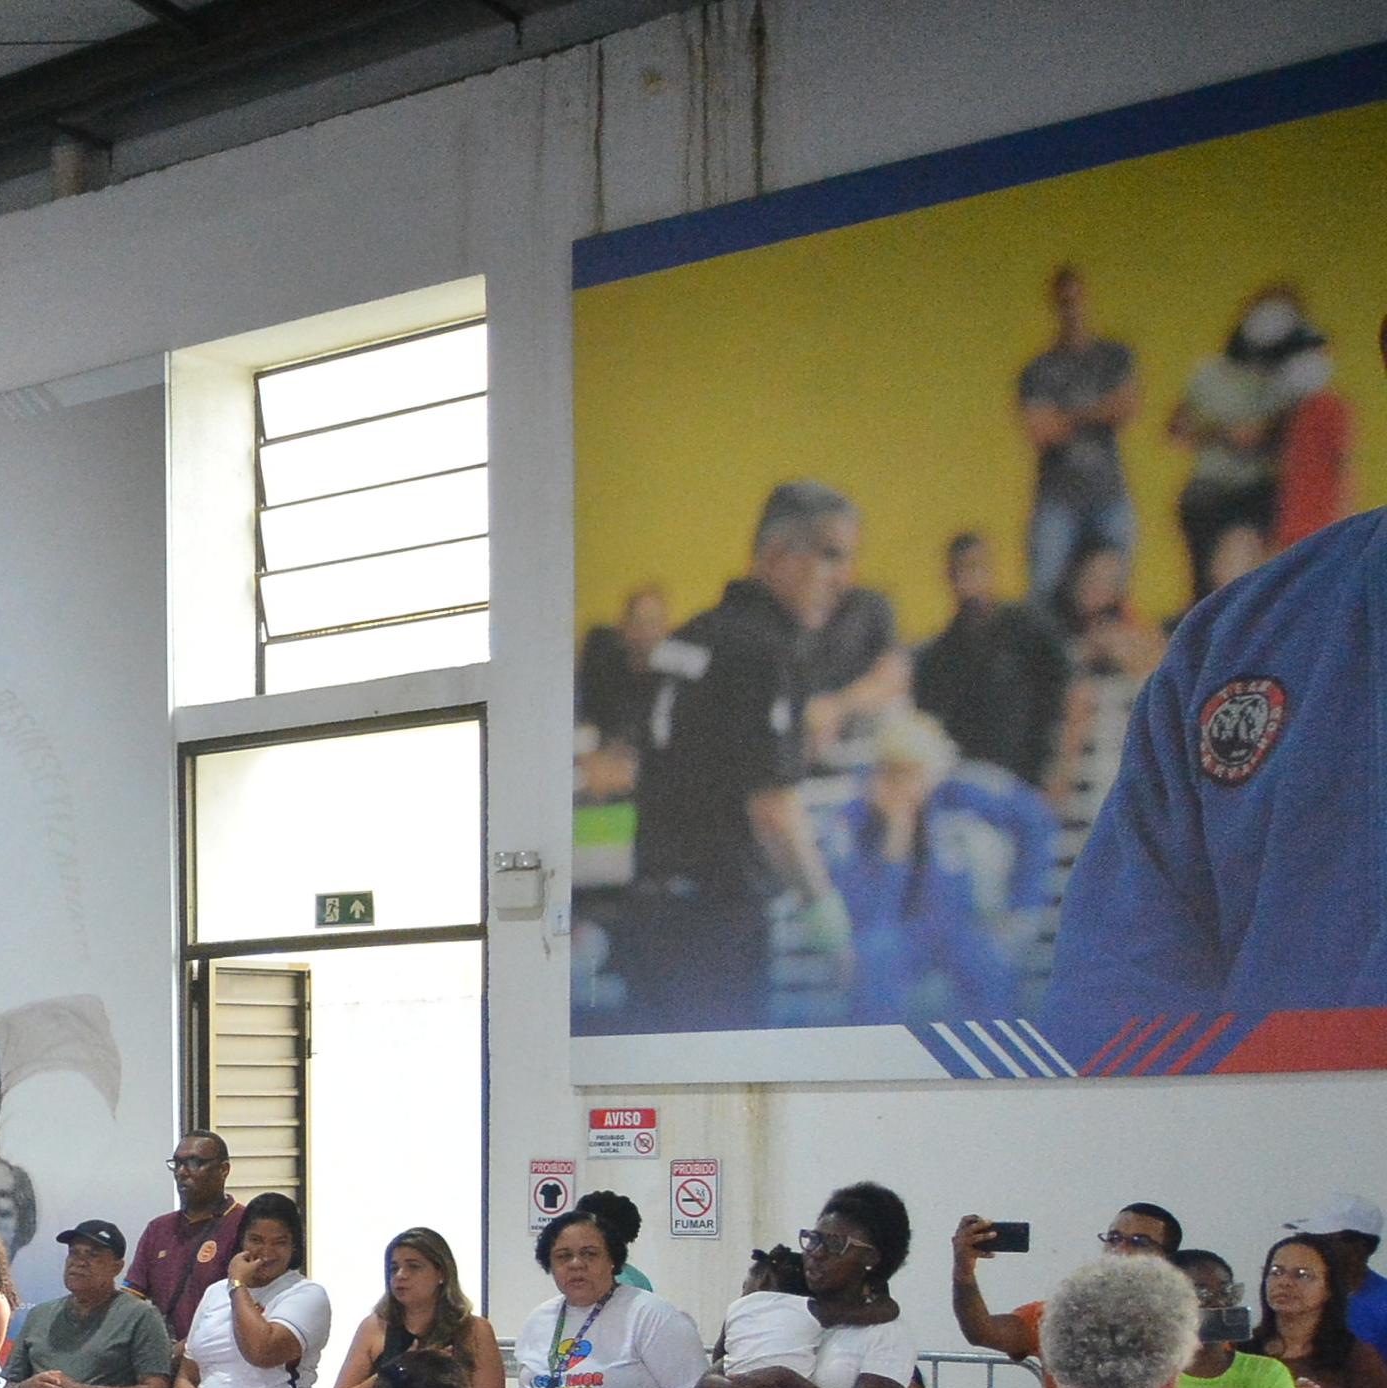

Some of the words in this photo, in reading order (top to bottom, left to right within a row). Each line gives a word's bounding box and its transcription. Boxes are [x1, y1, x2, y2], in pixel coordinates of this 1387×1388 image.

[603, 1111, 642, 1127] AVISO
[531, 1162, 573, 1174] PROIBIDO
[673, 1163, 715, 1175] PROIBIDO
[674, 1219, 715, 1229] FUMAR
